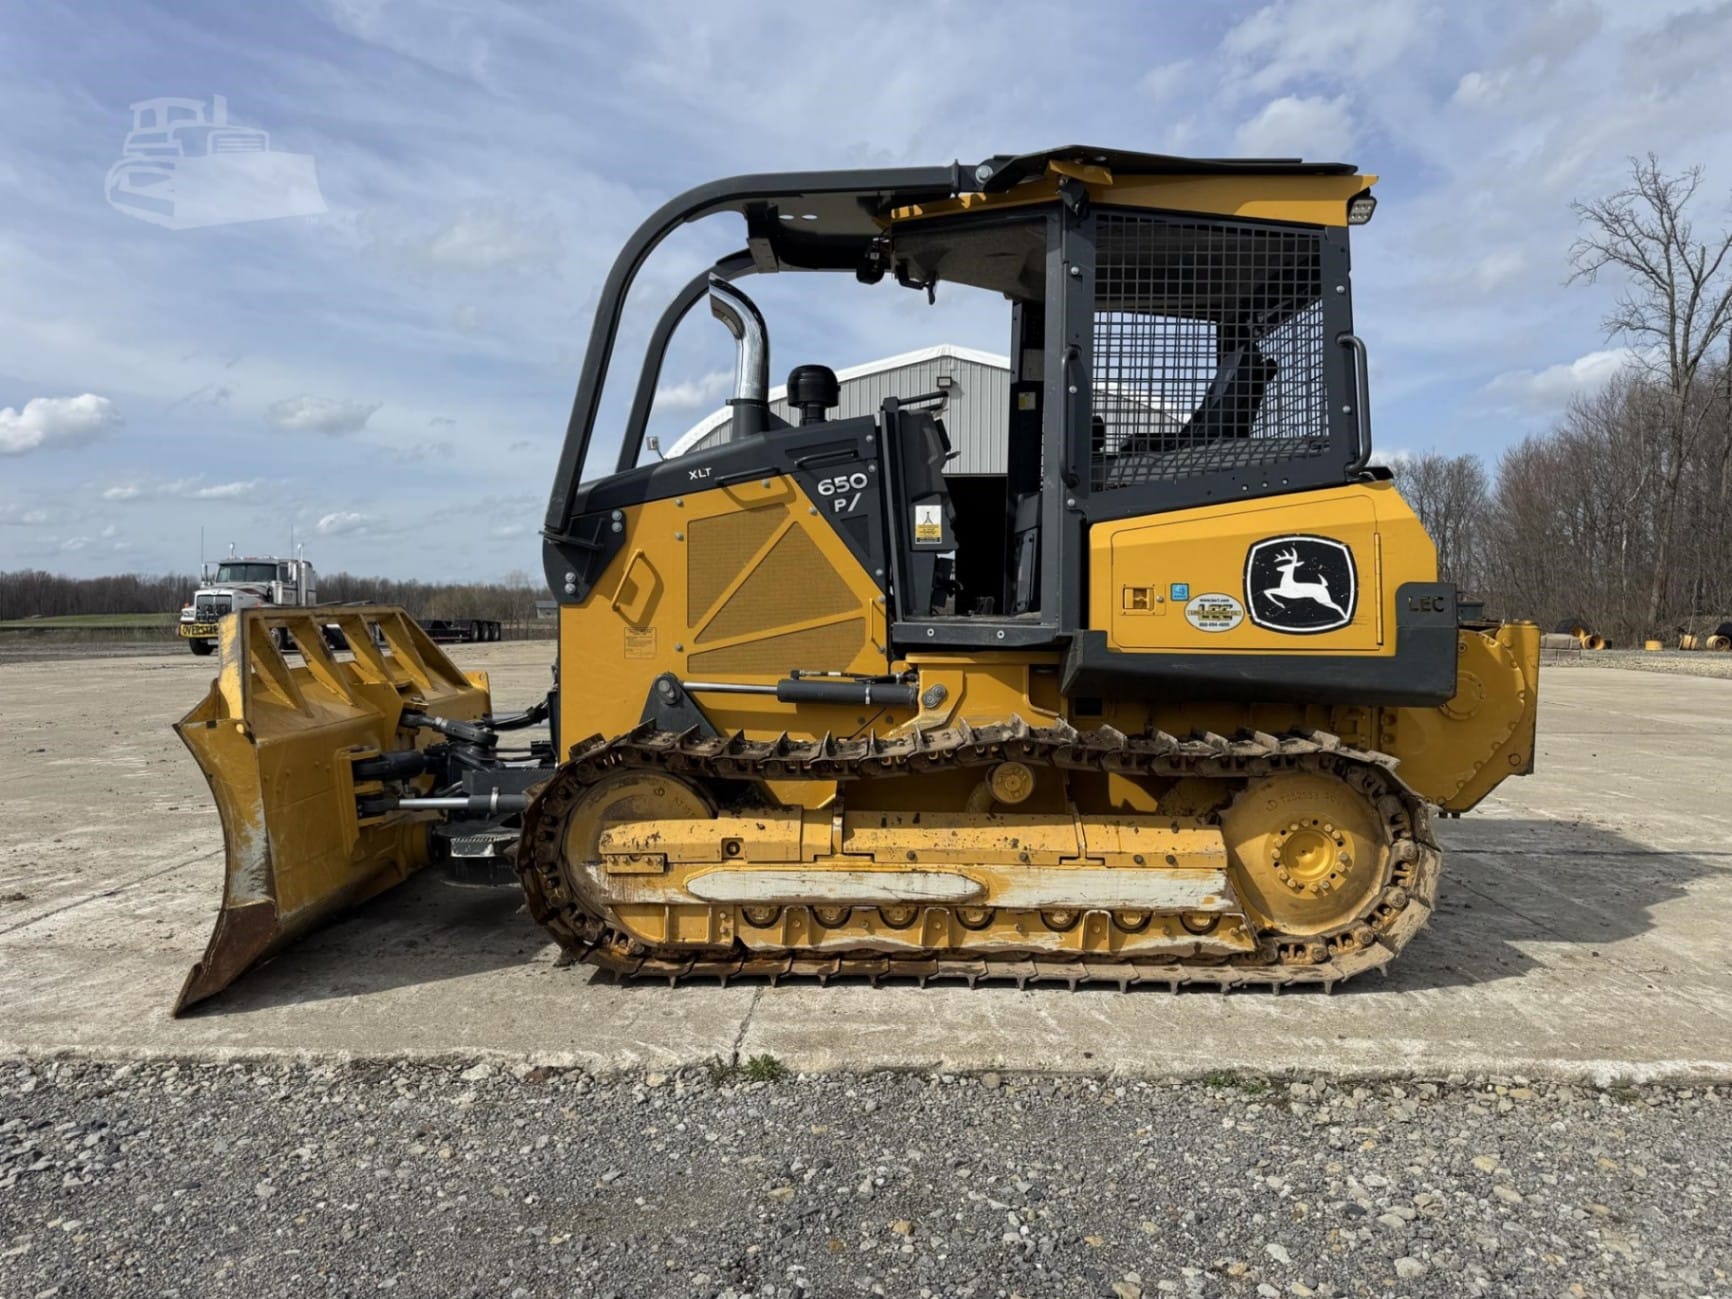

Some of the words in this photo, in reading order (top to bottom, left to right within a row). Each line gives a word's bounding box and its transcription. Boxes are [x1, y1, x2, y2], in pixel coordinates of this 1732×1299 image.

[688, 467, 712, 480] XLT
[817, 472, 868, 496] 650
[1408, 595, 1444, 613] LEC
